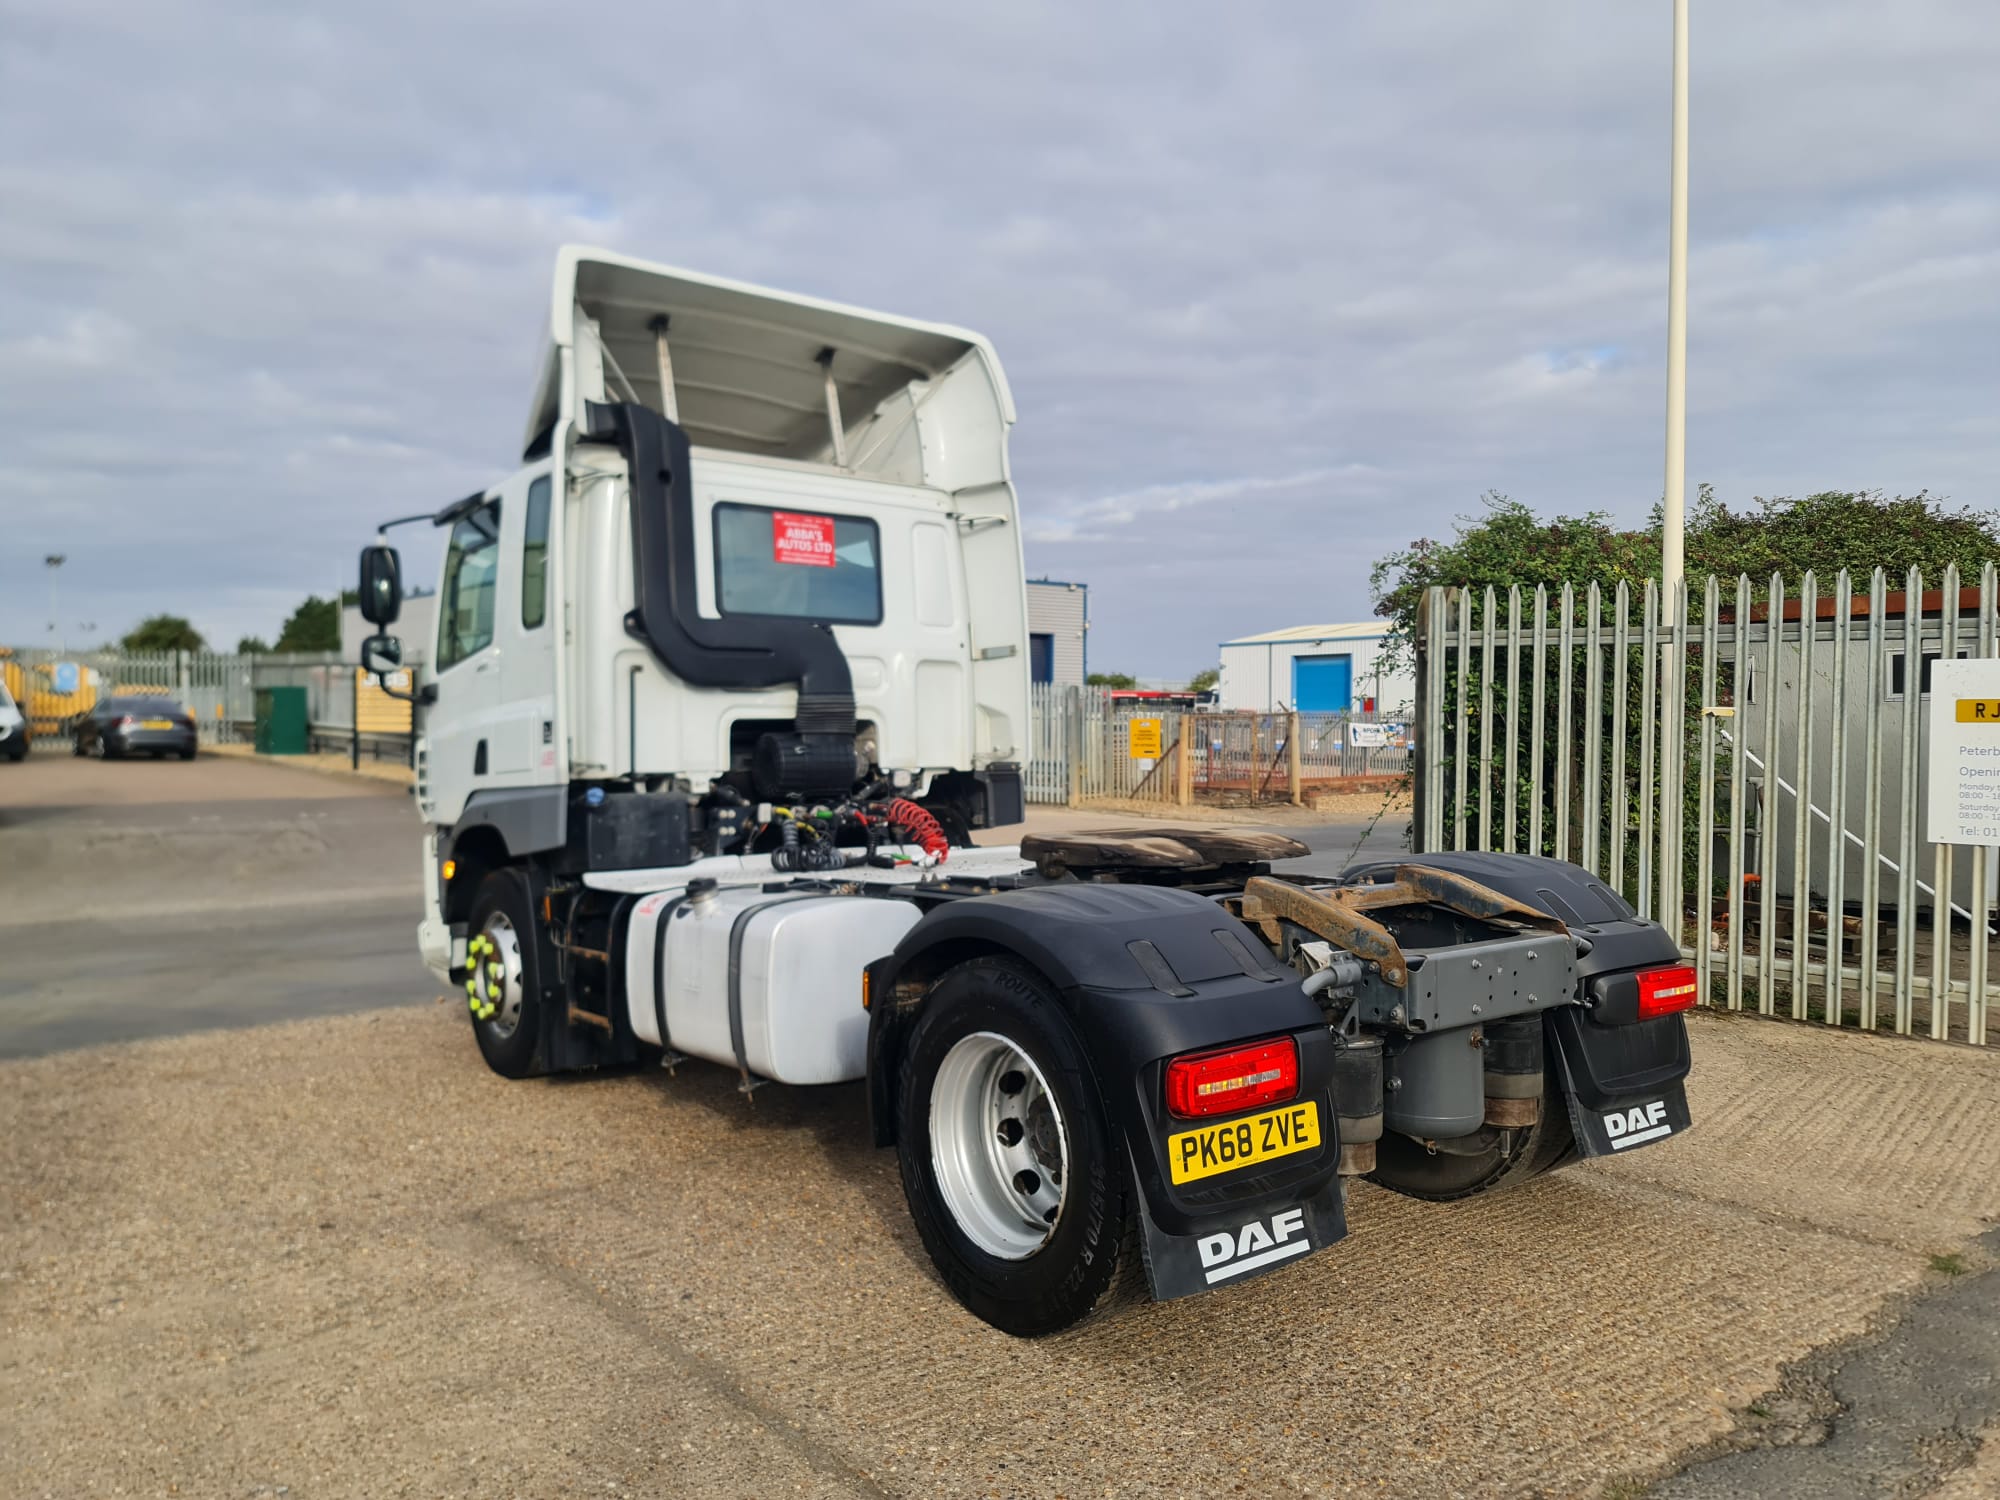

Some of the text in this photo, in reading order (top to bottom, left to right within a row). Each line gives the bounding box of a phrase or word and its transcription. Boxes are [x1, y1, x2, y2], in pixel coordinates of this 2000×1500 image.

[777, 538, 833, 554] AUTOS LTD
[1959, 783, 1994, 792] Monday
[1959, 803, 1999, 813] Saturday
[1603, 1101, 1667, 1138] DAF
[1181, 1109, 1309, 1173] PK68 ZVE
[1197, 1208, 1305, 1268] DAF
